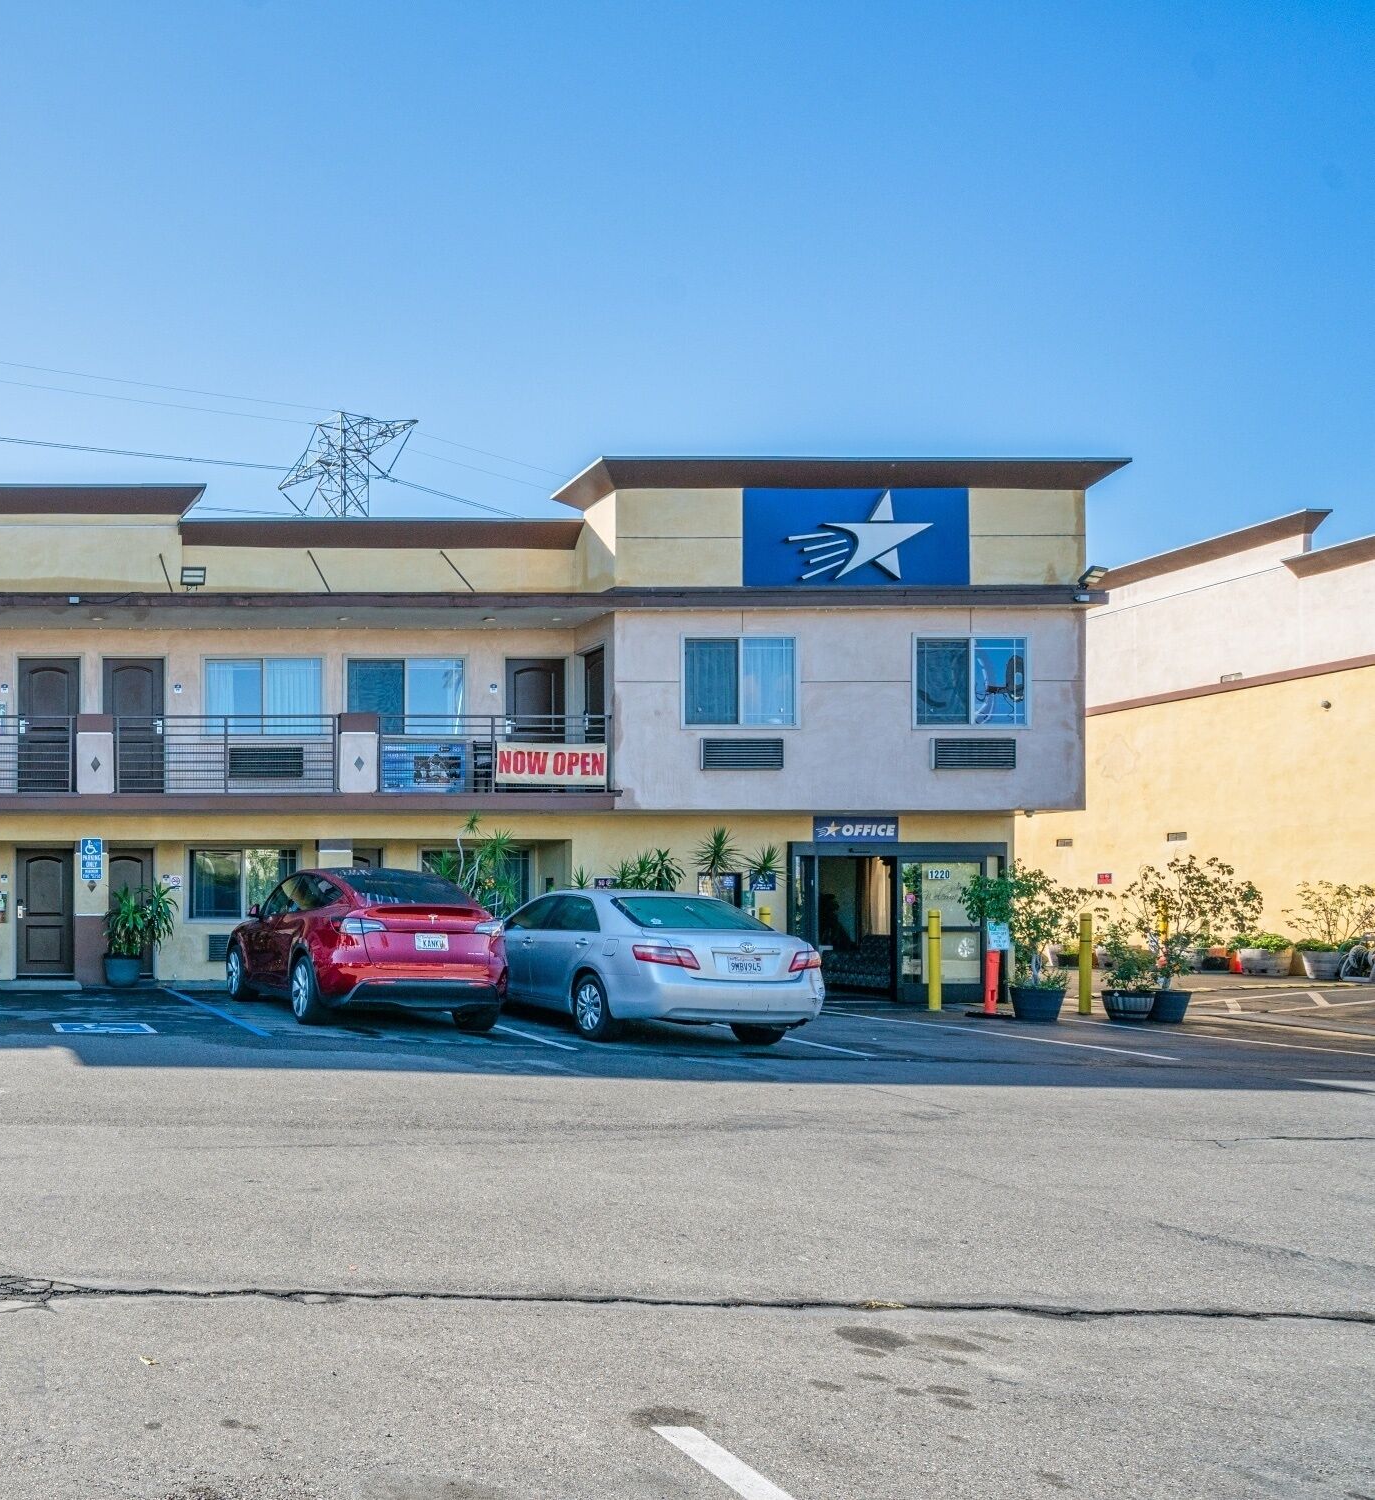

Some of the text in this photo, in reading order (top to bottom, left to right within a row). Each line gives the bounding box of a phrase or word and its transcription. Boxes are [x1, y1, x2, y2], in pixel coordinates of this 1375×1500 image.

[498, 750, 605, 776] NOW OPEN
[841, 824, 896, 837] OFFICE
[929, 870, 950, 879] 1220
[731, 962, 762, 972] 9MBV945
